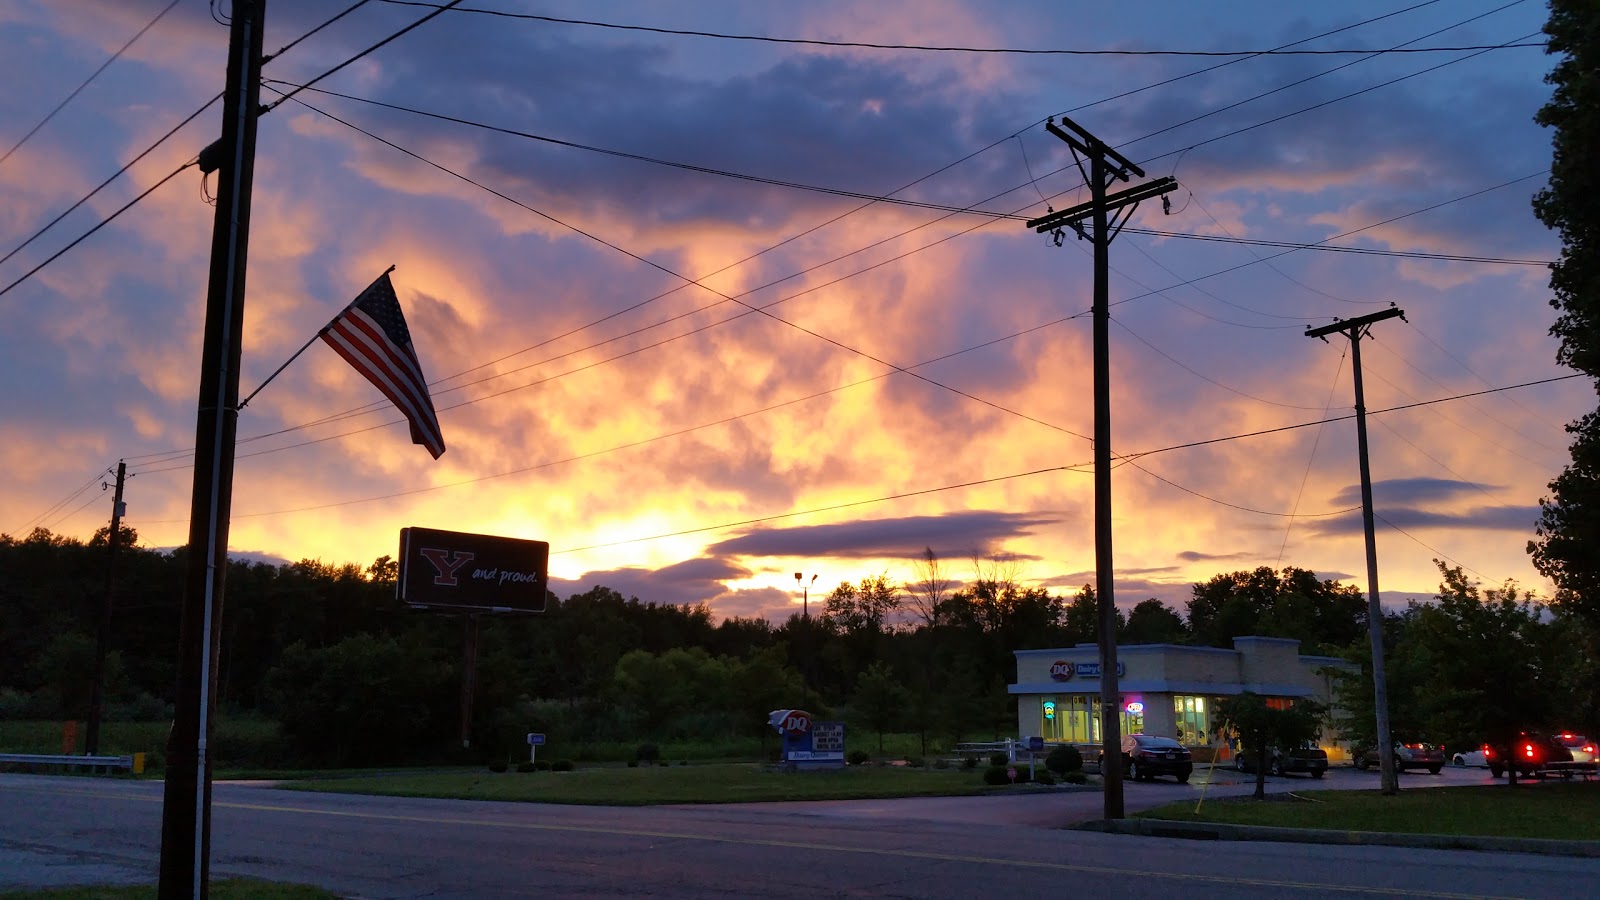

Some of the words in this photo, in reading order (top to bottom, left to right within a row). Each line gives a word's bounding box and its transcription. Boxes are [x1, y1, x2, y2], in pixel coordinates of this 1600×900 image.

[420, 548, 474, 586] Y
[472, 568, 497, 580] and
[499, 570, 537, 586] proud.
[1053, 664, 1069, 675] DQ
[1078, 665, 1097, 674] Dairy
[787, 717, 807, 731] DQ
